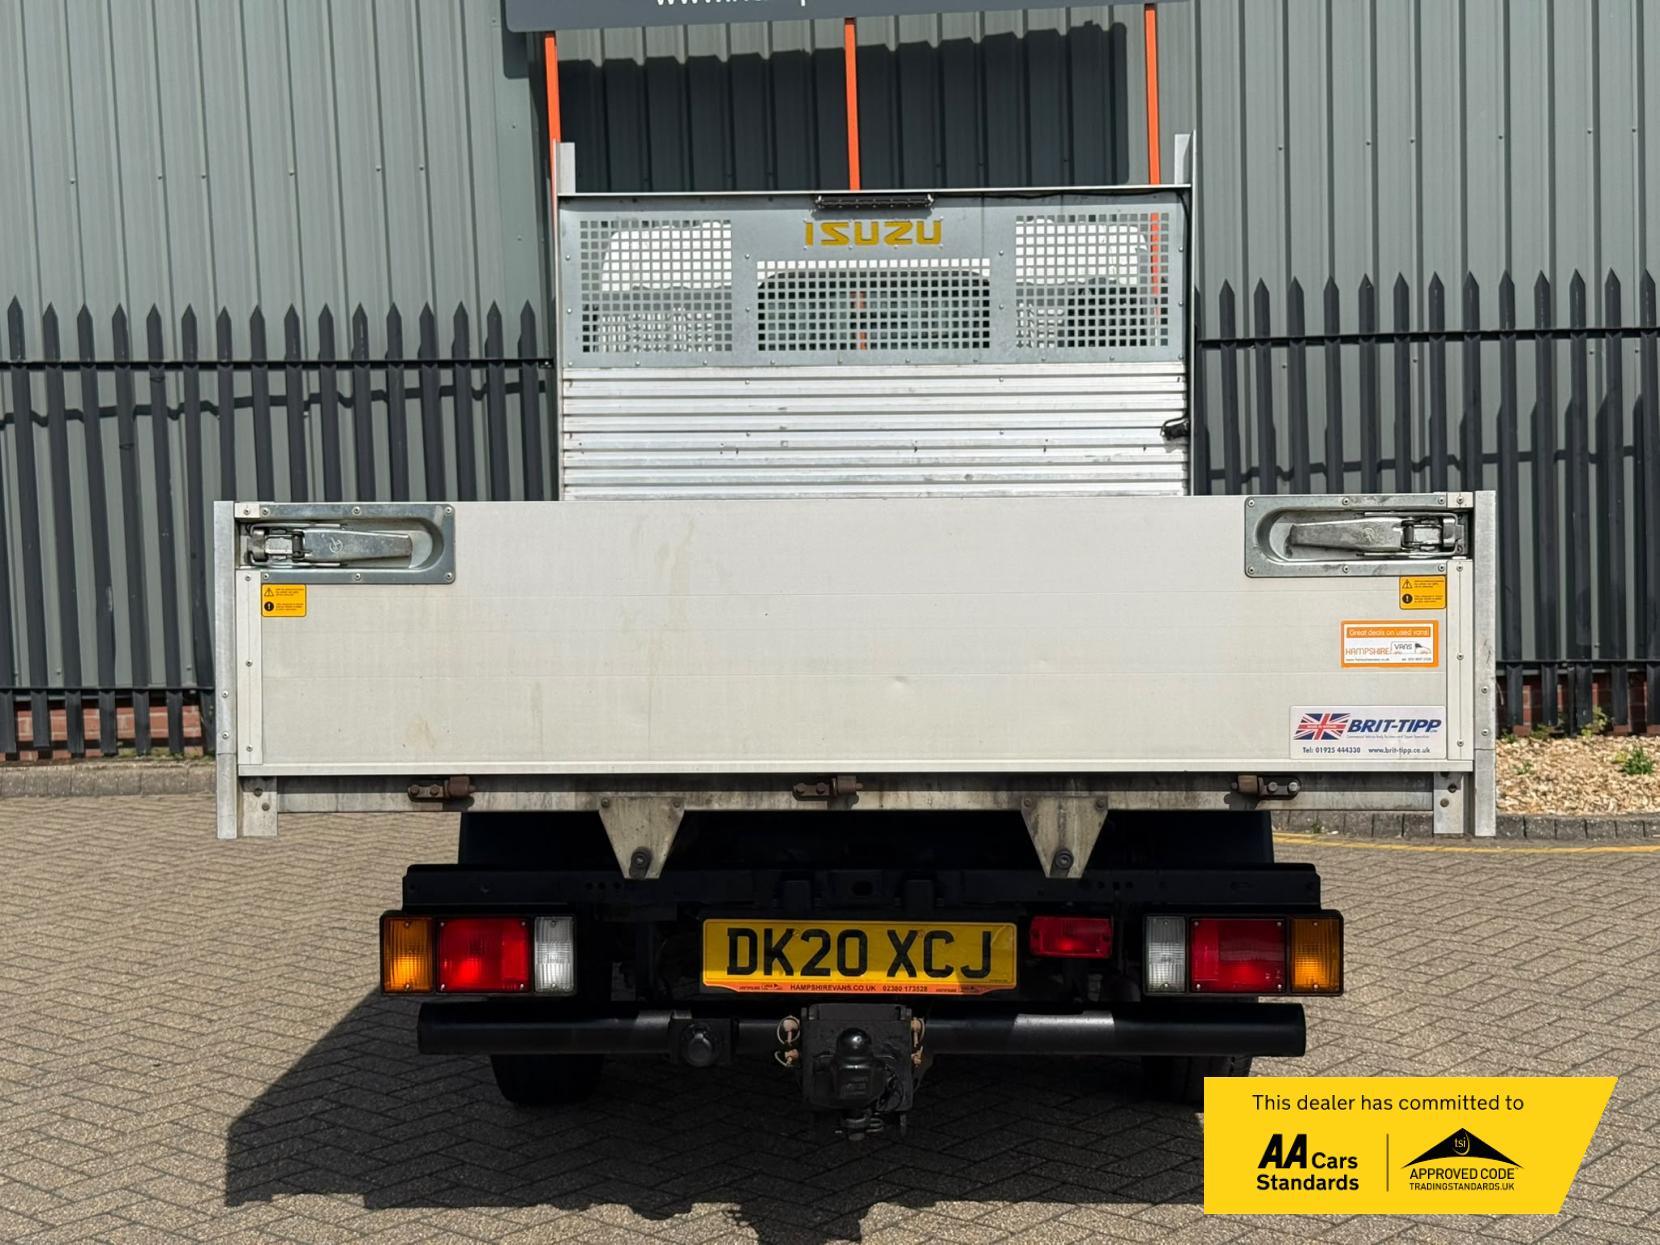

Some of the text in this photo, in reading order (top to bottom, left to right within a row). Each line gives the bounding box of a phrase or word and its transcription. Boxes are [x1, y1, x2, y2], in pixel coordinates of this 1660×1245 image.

[805, 221, 942, 246] ISUZU
[1345, 647, 1389, 656] HAMPSHIRE
[1347, 719, 1442, 733] BRIT-TIPP
[1302, 746, 1314, 754] Tel:
[1368, 746, 1431, 755] www.brit-tipp.co.uk
[727, 927, 992, 979] DK20 XCJ
[790, 983, 877, 993] HAMPSHIREVANS.CO.UK
